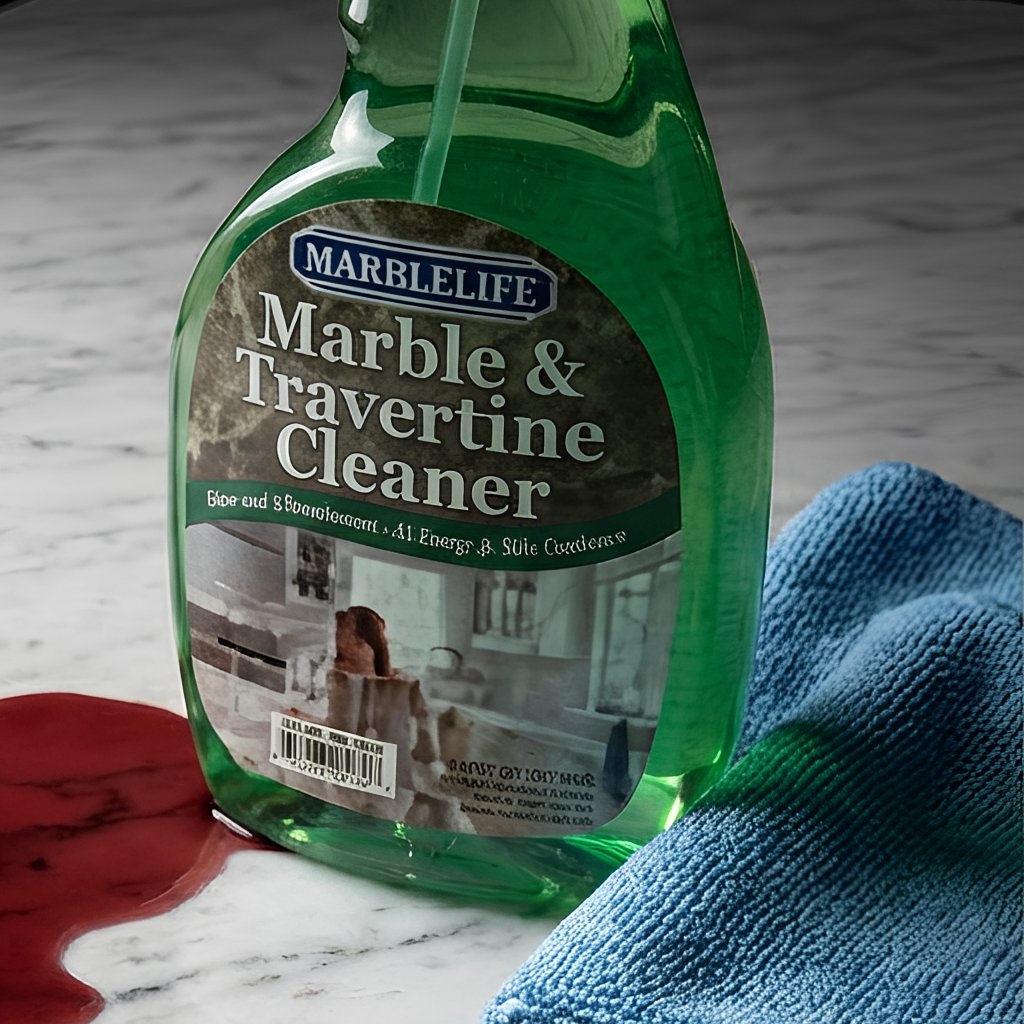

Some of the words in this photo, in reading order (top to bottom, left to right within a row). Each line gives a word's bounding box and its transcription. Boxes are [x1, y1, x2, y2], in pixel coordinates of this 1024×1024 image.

[306, 242, 539, 308] MARBLELIFE
[257, 291, 507, 390] Marble
[526, 339, 586, 398] &
[235, 347, 606, 463] Travertine
[277, 423, 551, 520] Cleaner
